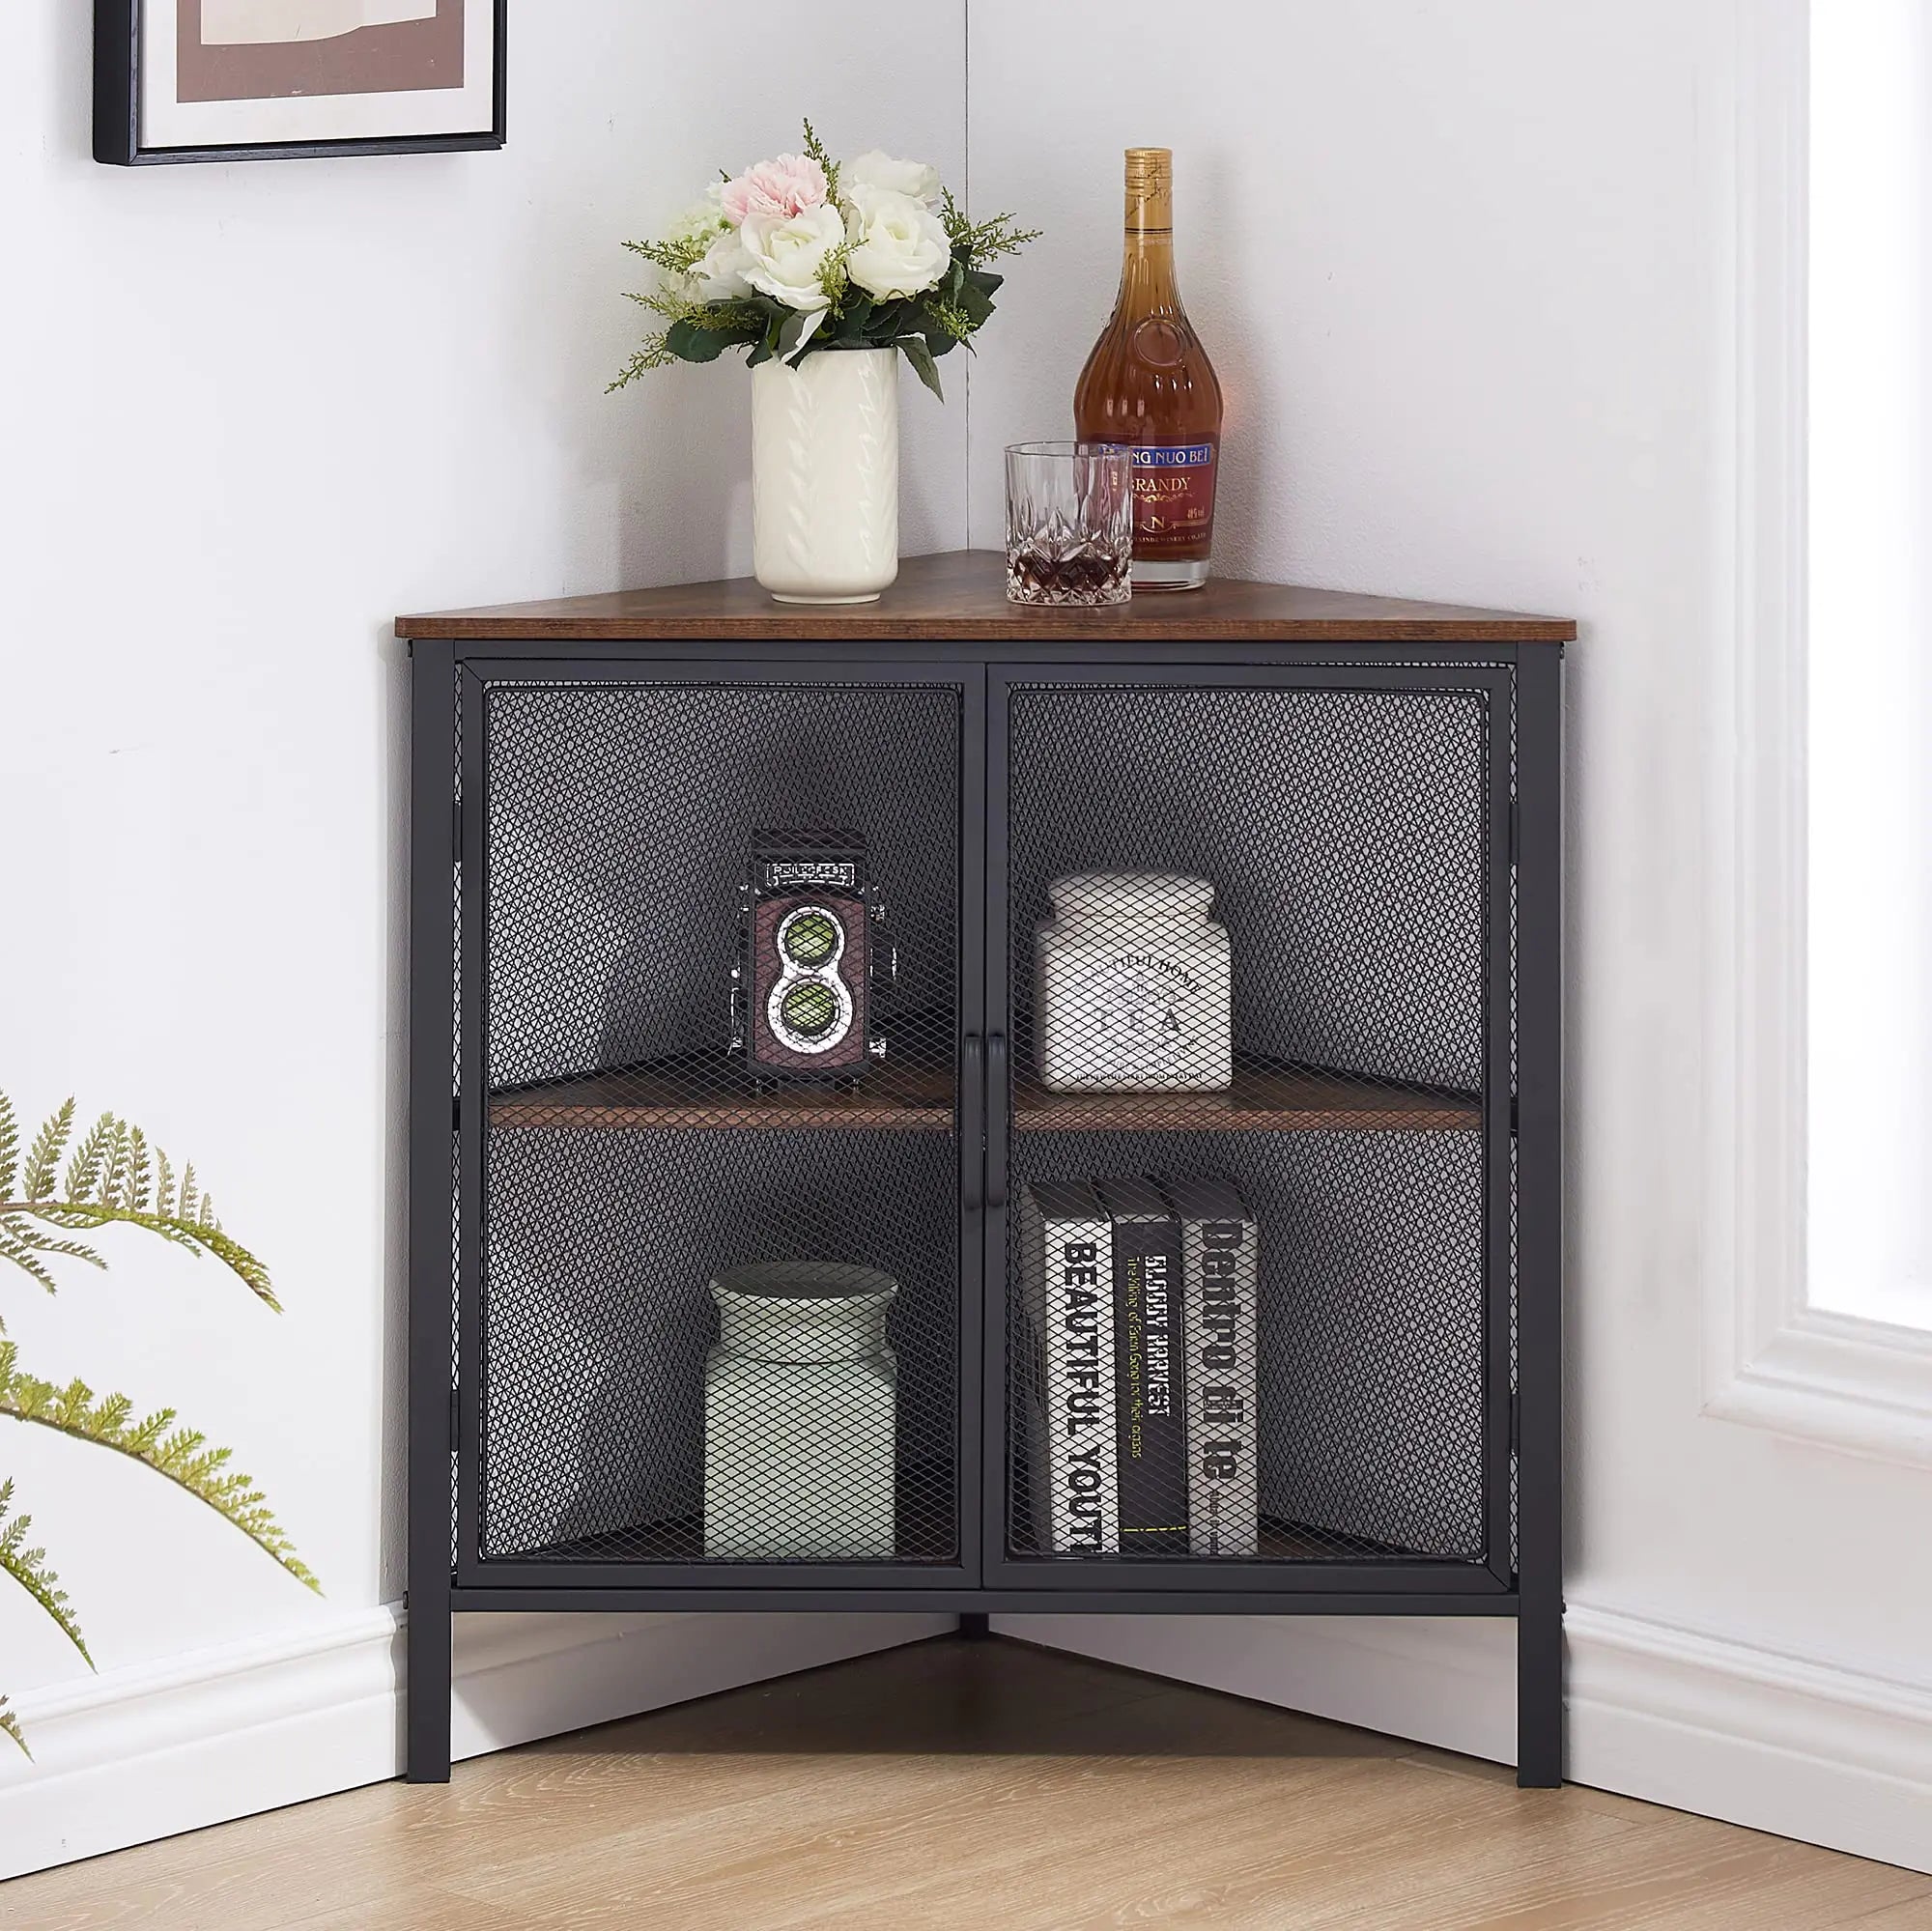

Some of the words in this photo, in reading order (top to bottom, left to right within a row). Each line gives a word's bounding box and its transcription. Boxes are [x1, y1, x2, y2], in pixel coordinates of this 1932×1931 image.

[1155, 451, 1186, 464] NUO
[1189, 447, 1208, 463] BEI
[1145, 1255, 1168, 1327] BLOODY
[1202, 1223, 1243, 1370] Dentro
[1065, 1242, 1100, 1436] BEAUTIFUL
[1147, 1334, 1171, 1416] HARVEST
[1128, 1424, 1144, 1459] organs
[1204, 1440, 1242, 1480] te
